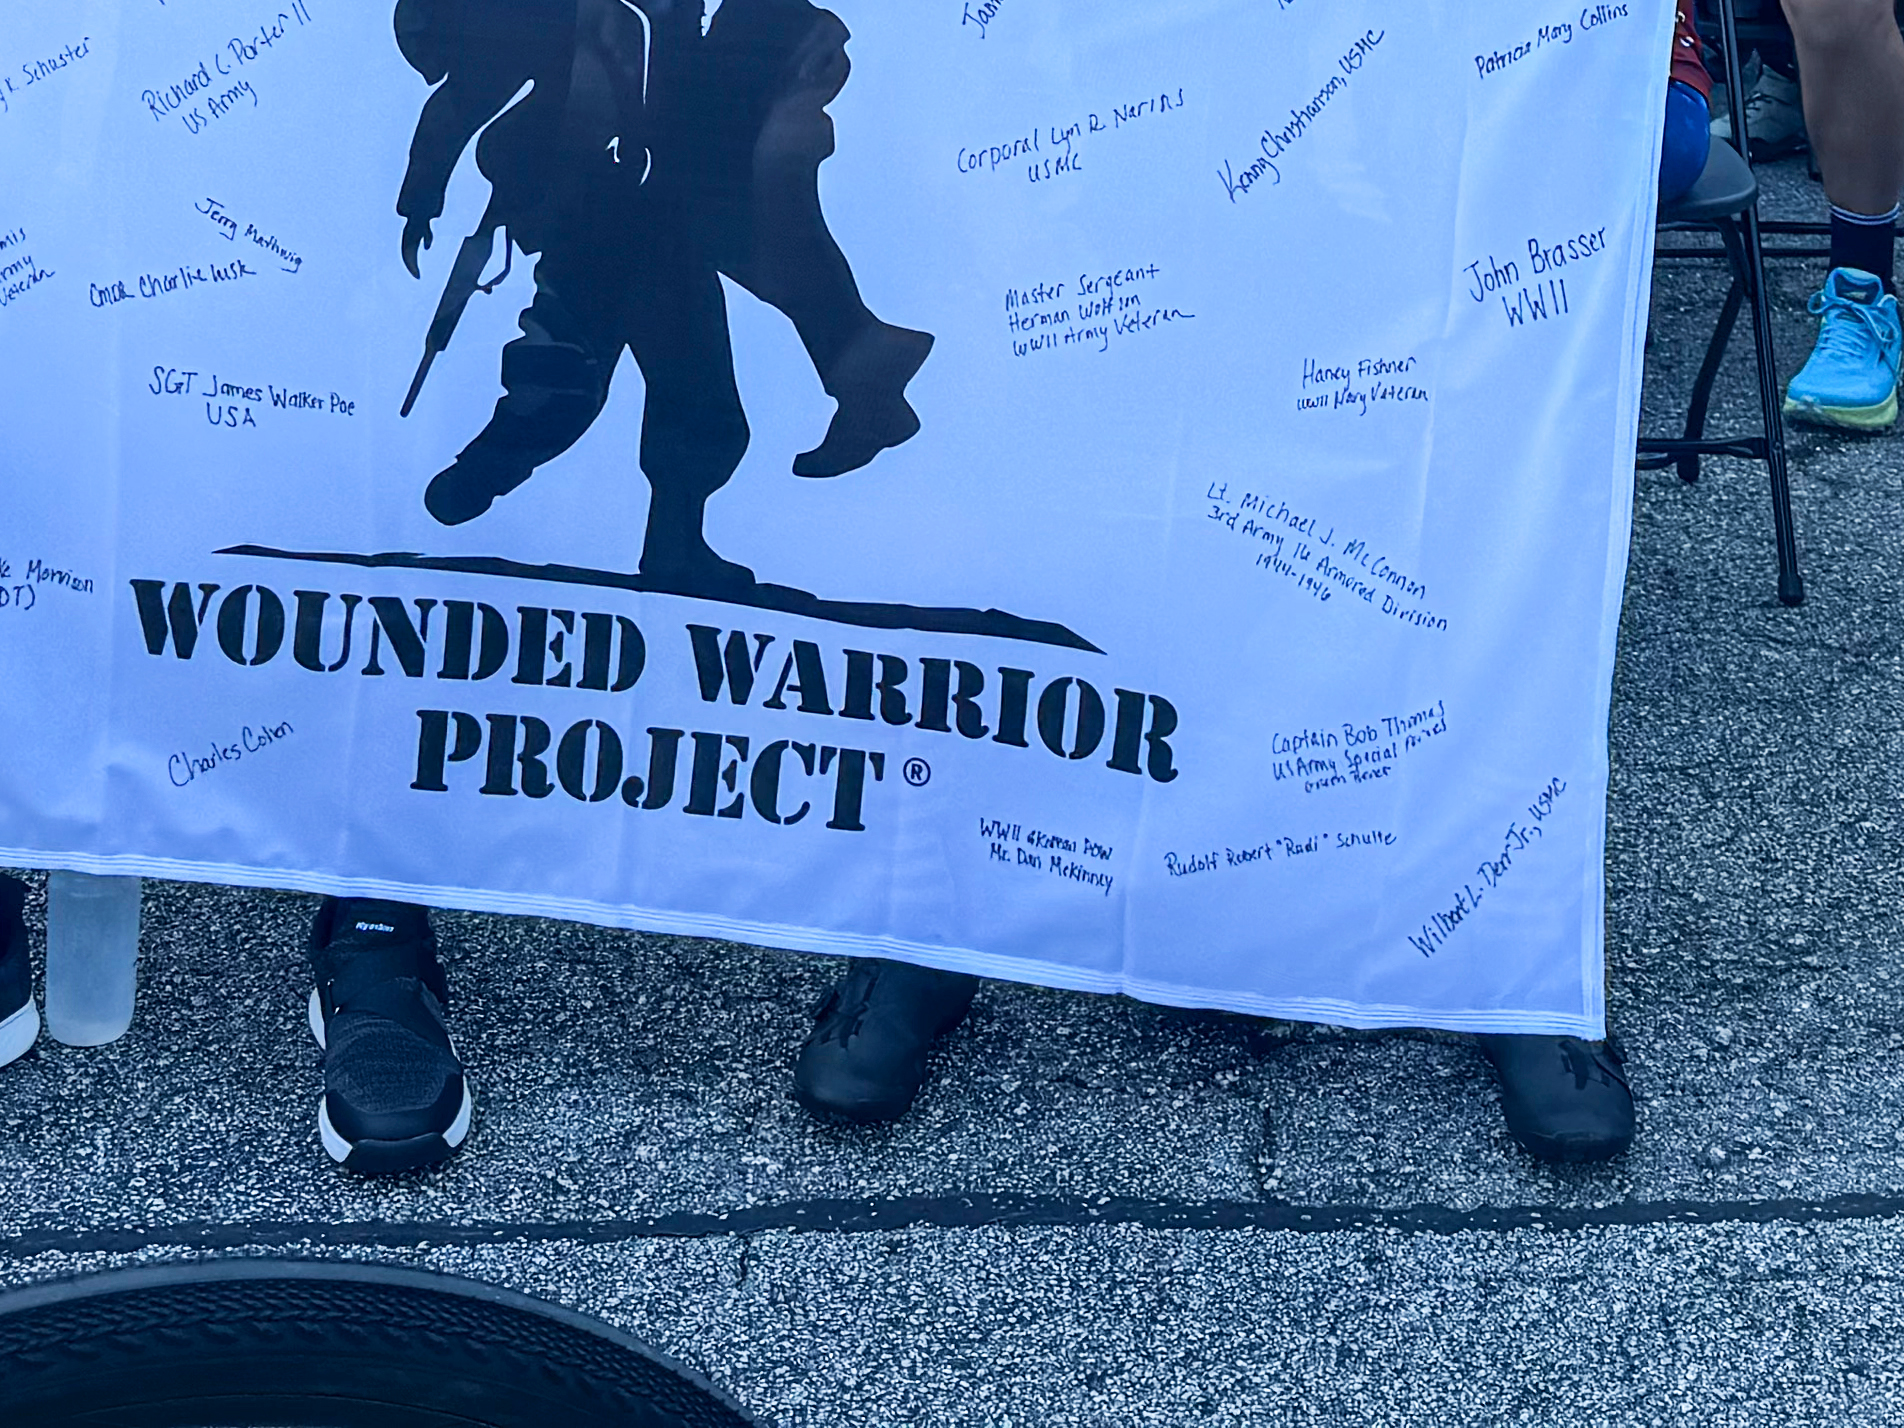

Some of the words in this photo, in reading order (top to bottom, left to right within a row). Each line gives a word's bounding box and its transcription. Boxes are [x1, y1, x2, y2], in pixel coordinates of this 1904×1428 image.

[957, 127, 1040, 173] Corporal
[1005, 282, 1065, 312] Master
[1077, 263, 1160, 299] Sergeant
[1462, 255, 1520, 303] John
[1527, 226, 1607, 275] Brasser
[149, 365, 199, 395] SGT
[202, 373, 264, 403] James
[206, 401, 257, 428] USA
[1240, 492, 1316, 538] Michael
[129, 578, 647, 694] WOUNDED
[684, 622, 1183, 784] WARRIOR
[1341, 722, 1378, 748] Bob
[168, 741, 242, 787] Charles
